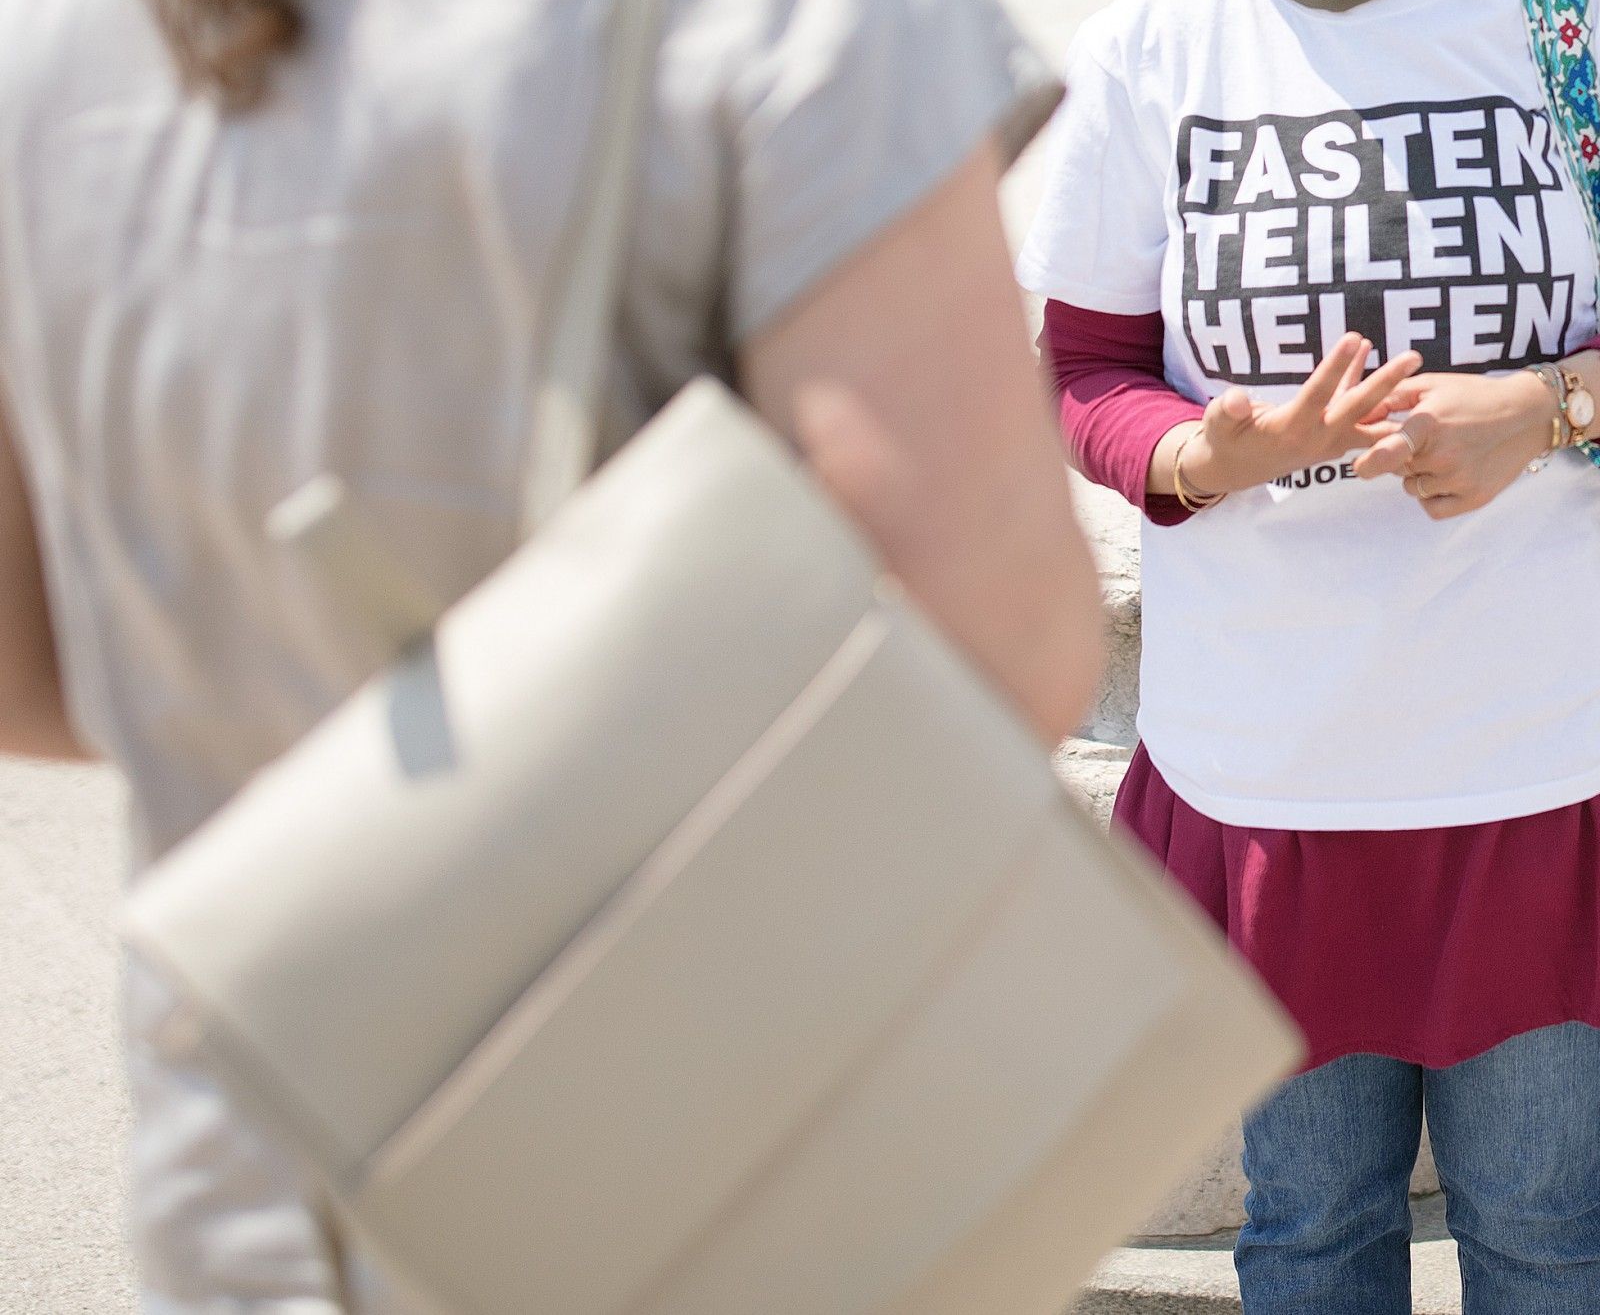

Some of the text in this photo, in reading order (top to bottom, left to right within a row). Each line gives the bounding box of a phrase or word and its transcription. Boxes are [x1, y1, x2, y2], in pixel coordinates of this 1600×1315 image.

[1185, 108, 1554, 204] FASTEN
[1183, 196, 1544, 290] TEILEN
[1188, 282, 1569, 375] HELFEN
